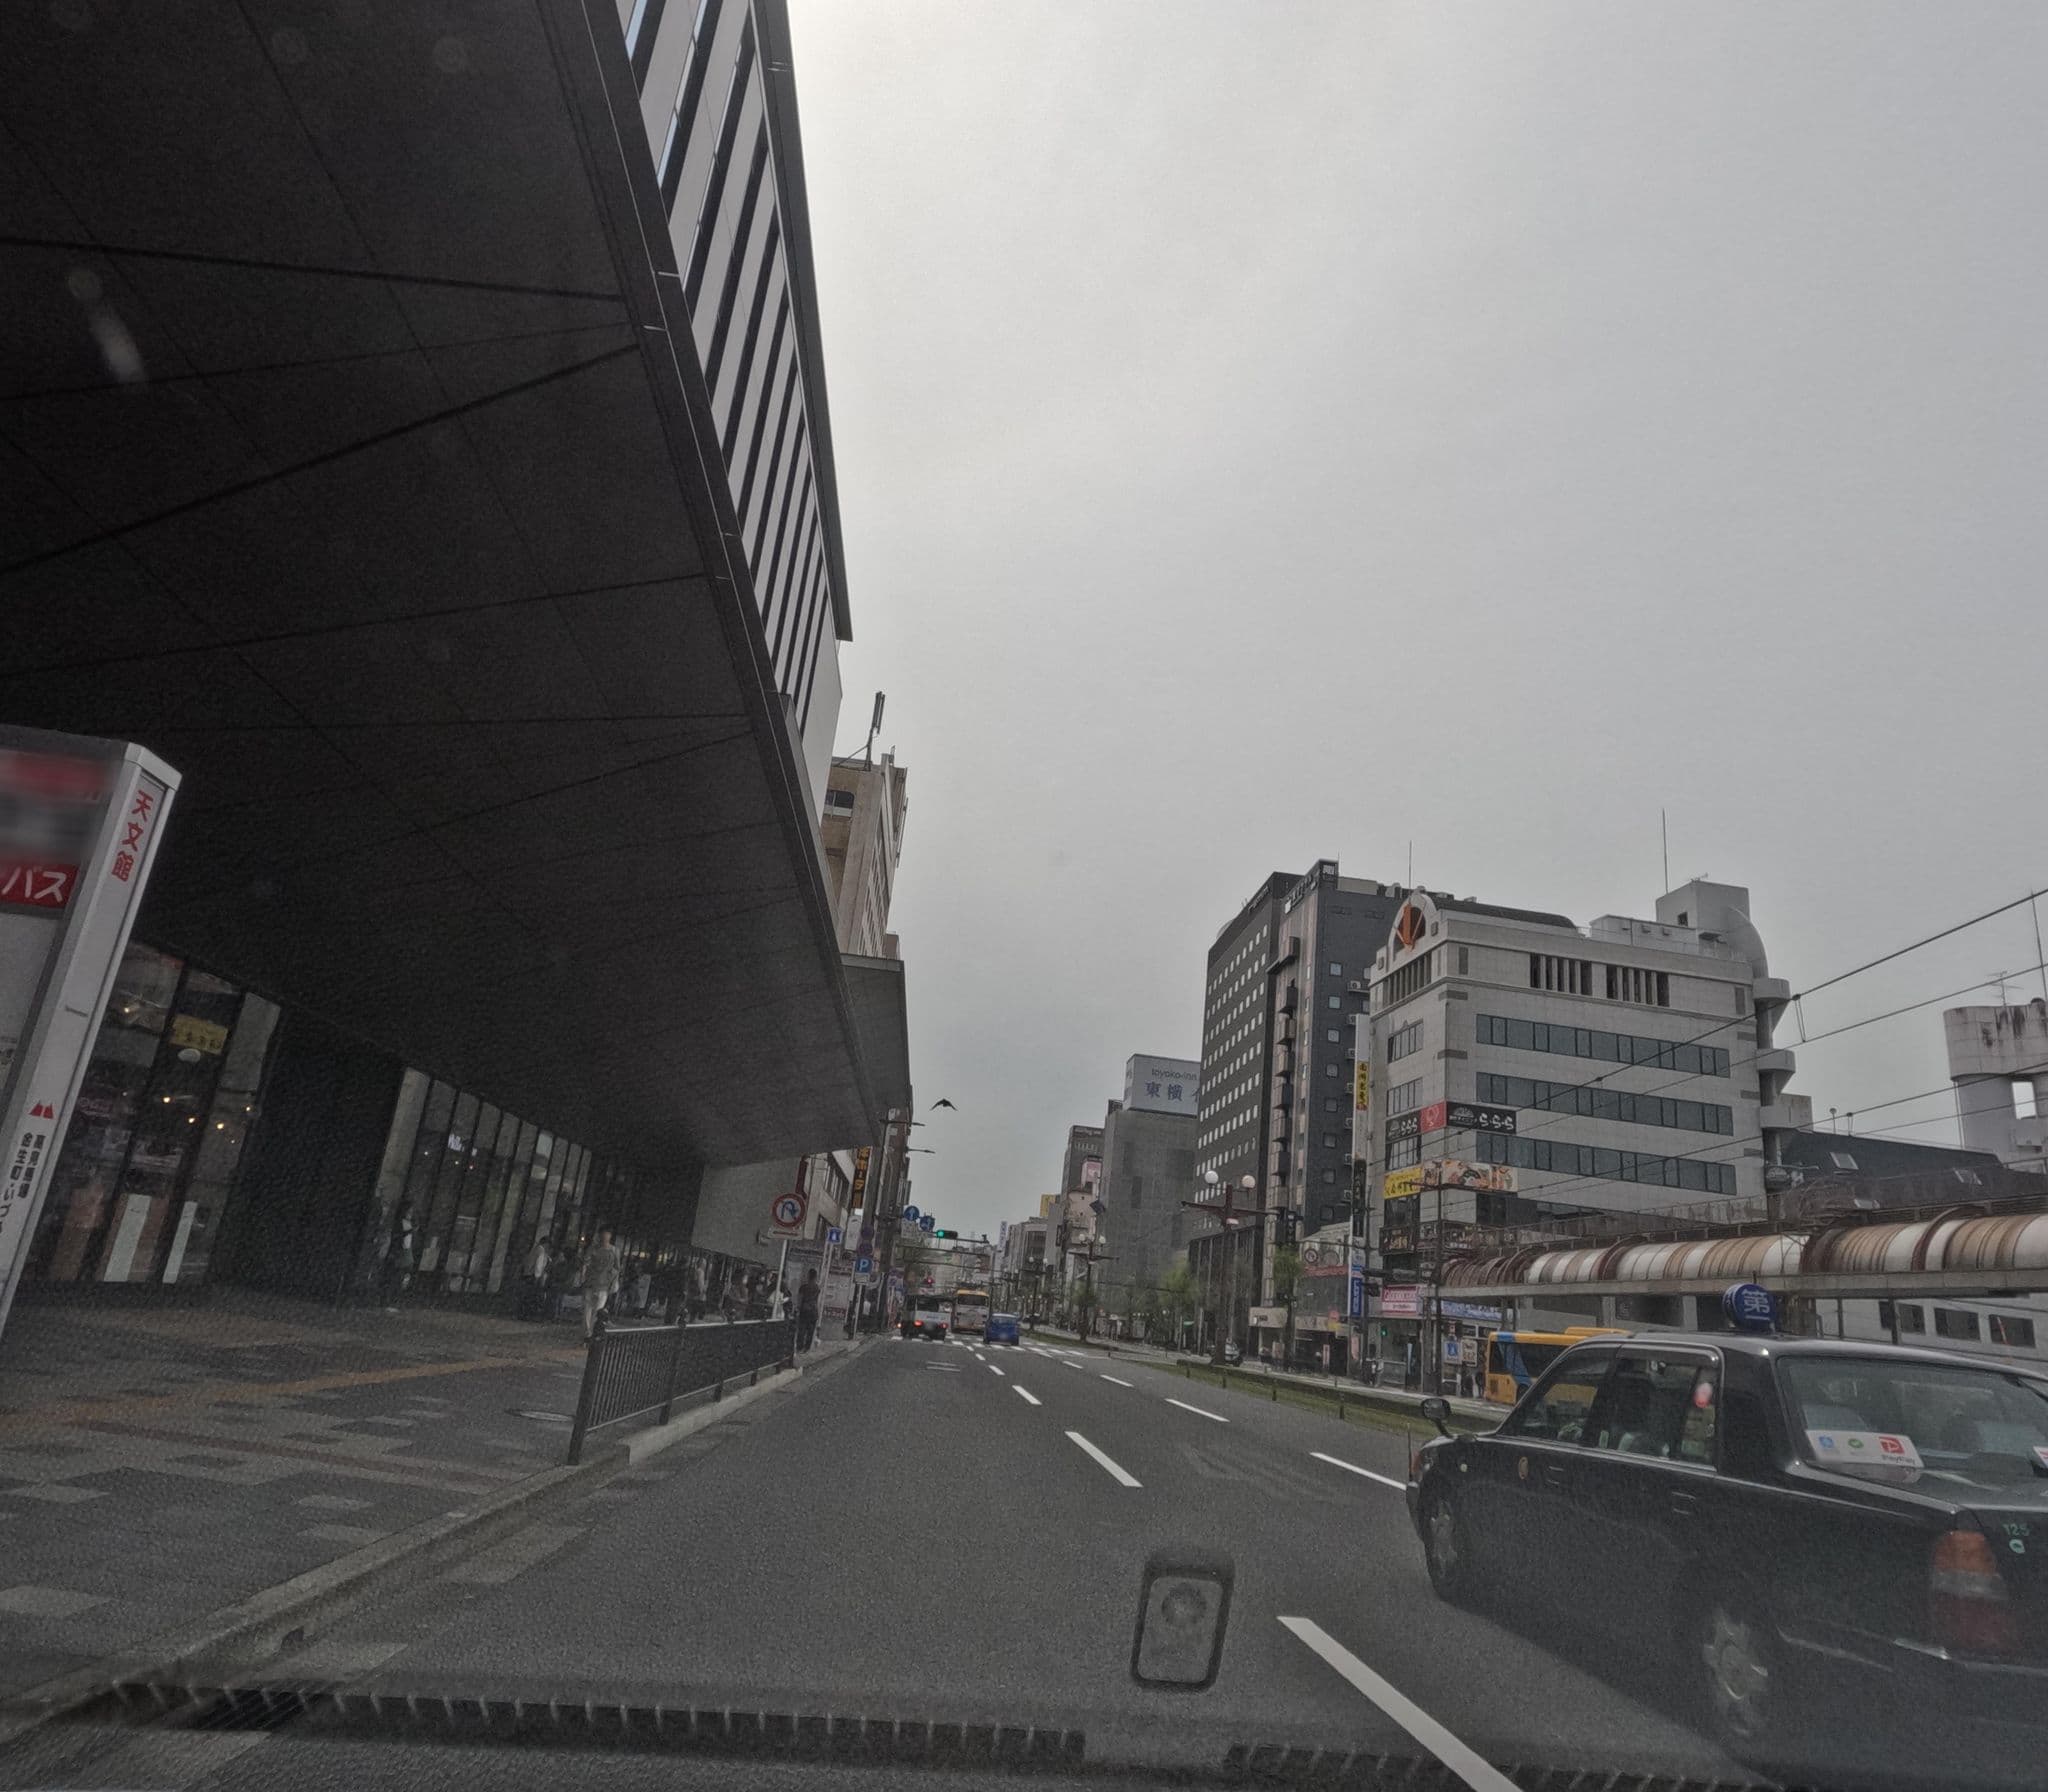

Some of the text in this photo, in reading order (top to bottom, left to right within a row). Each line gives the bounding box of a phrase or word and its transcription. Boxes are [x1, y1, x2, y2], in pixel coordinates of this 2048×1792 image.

[110, 789, 155, 883] 天文館
[1741, 1288, 1771, 1321] 第一
